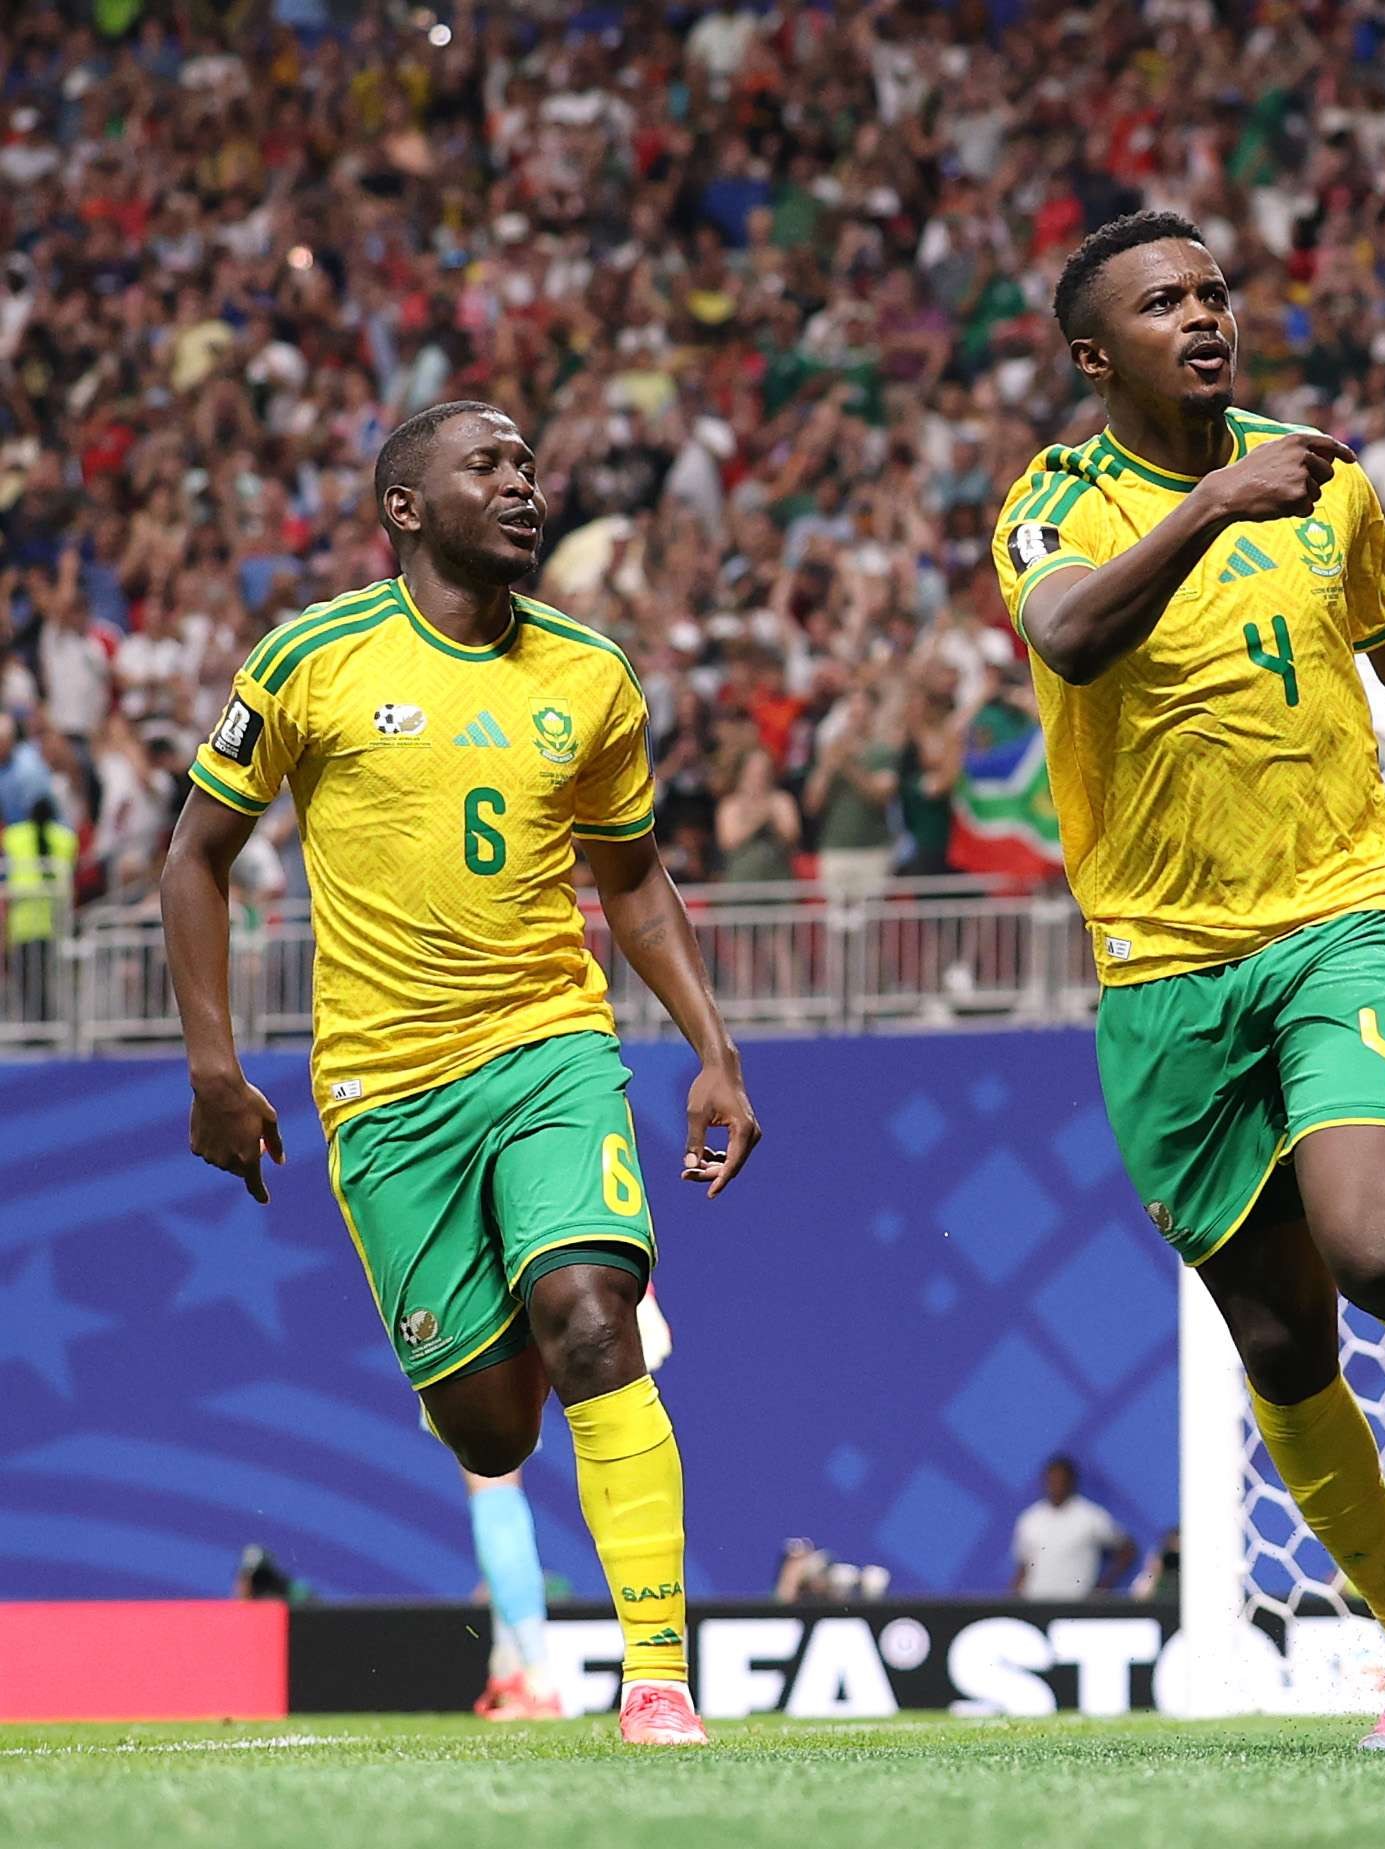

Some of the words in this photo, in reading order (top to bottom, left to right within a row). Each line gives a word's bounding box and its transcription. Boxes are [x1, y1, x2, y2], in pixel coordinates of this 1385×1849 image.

[1243, 615, 1299, 707] 4
[464, 787, 506, 876] 6
[601, 1132, 644, 1217] 6
[621, 1581, 682, 1603] SAFA
[544, 1616, 900, 1719] FFA
